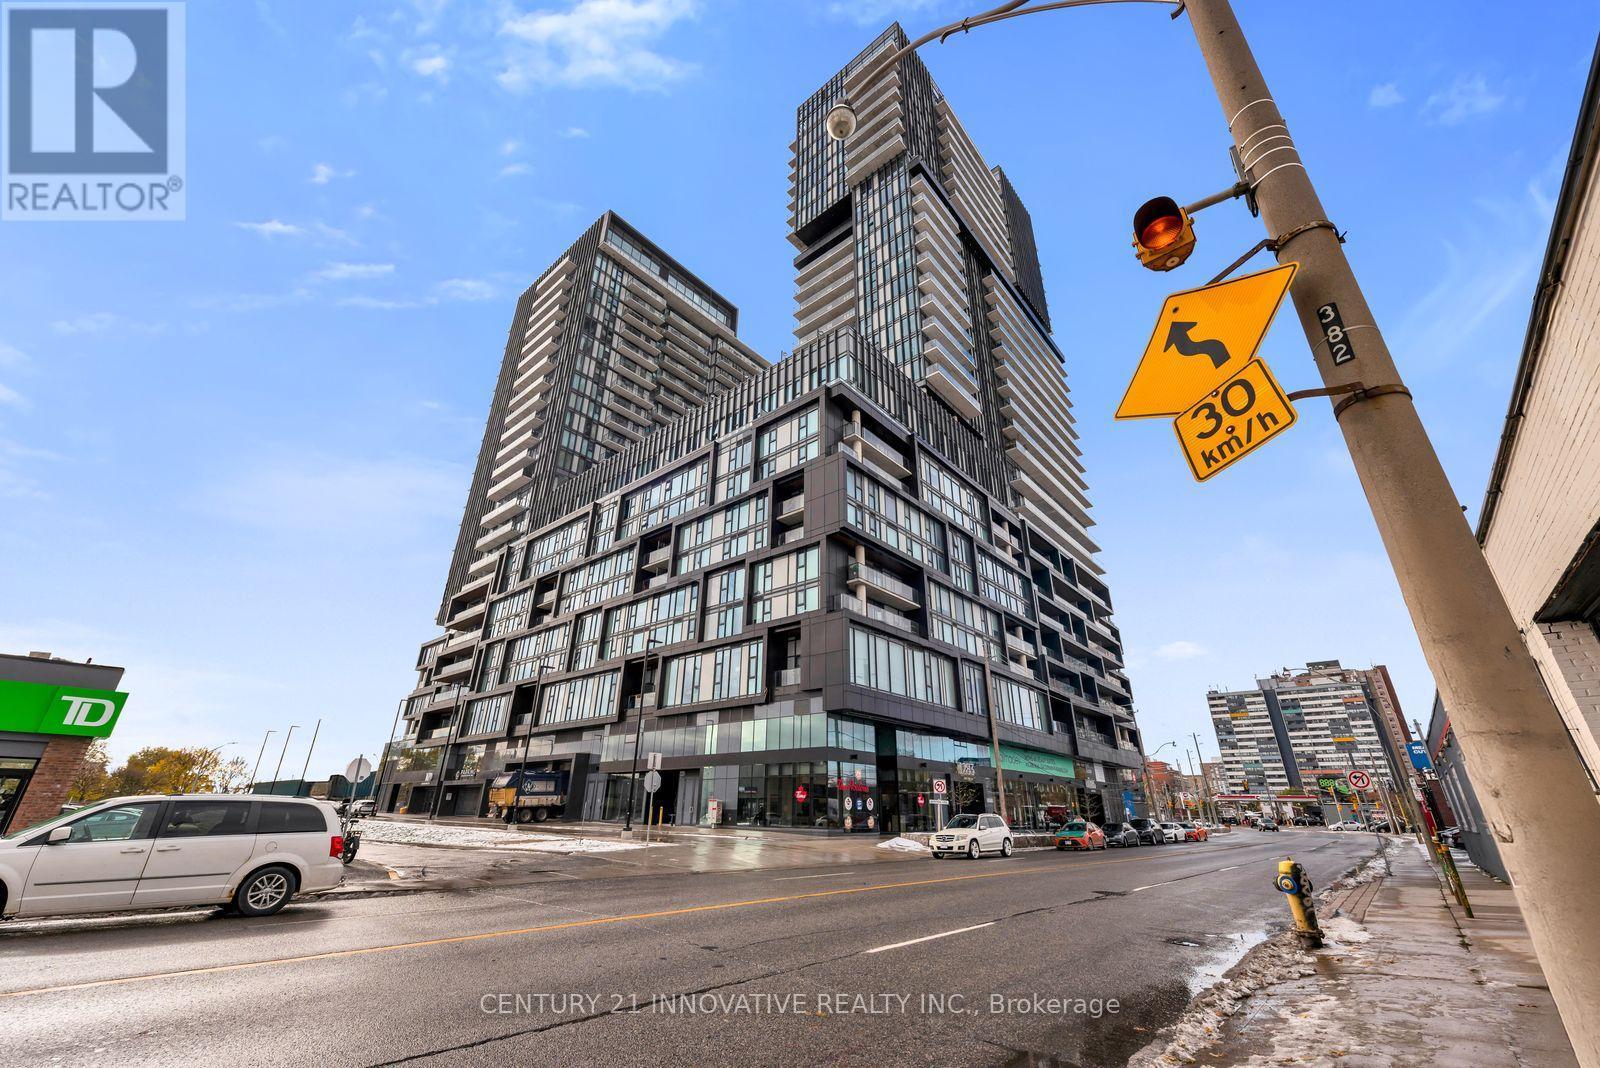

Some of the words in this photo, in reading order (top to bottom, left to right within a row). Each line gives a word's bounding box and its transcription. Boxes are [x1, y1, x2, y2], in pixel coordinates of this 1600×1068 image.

[1191, 378, 1256, 440] 30
[1201, 411, 1280, 470] km/h
[61, 695, 116, 727] TD
